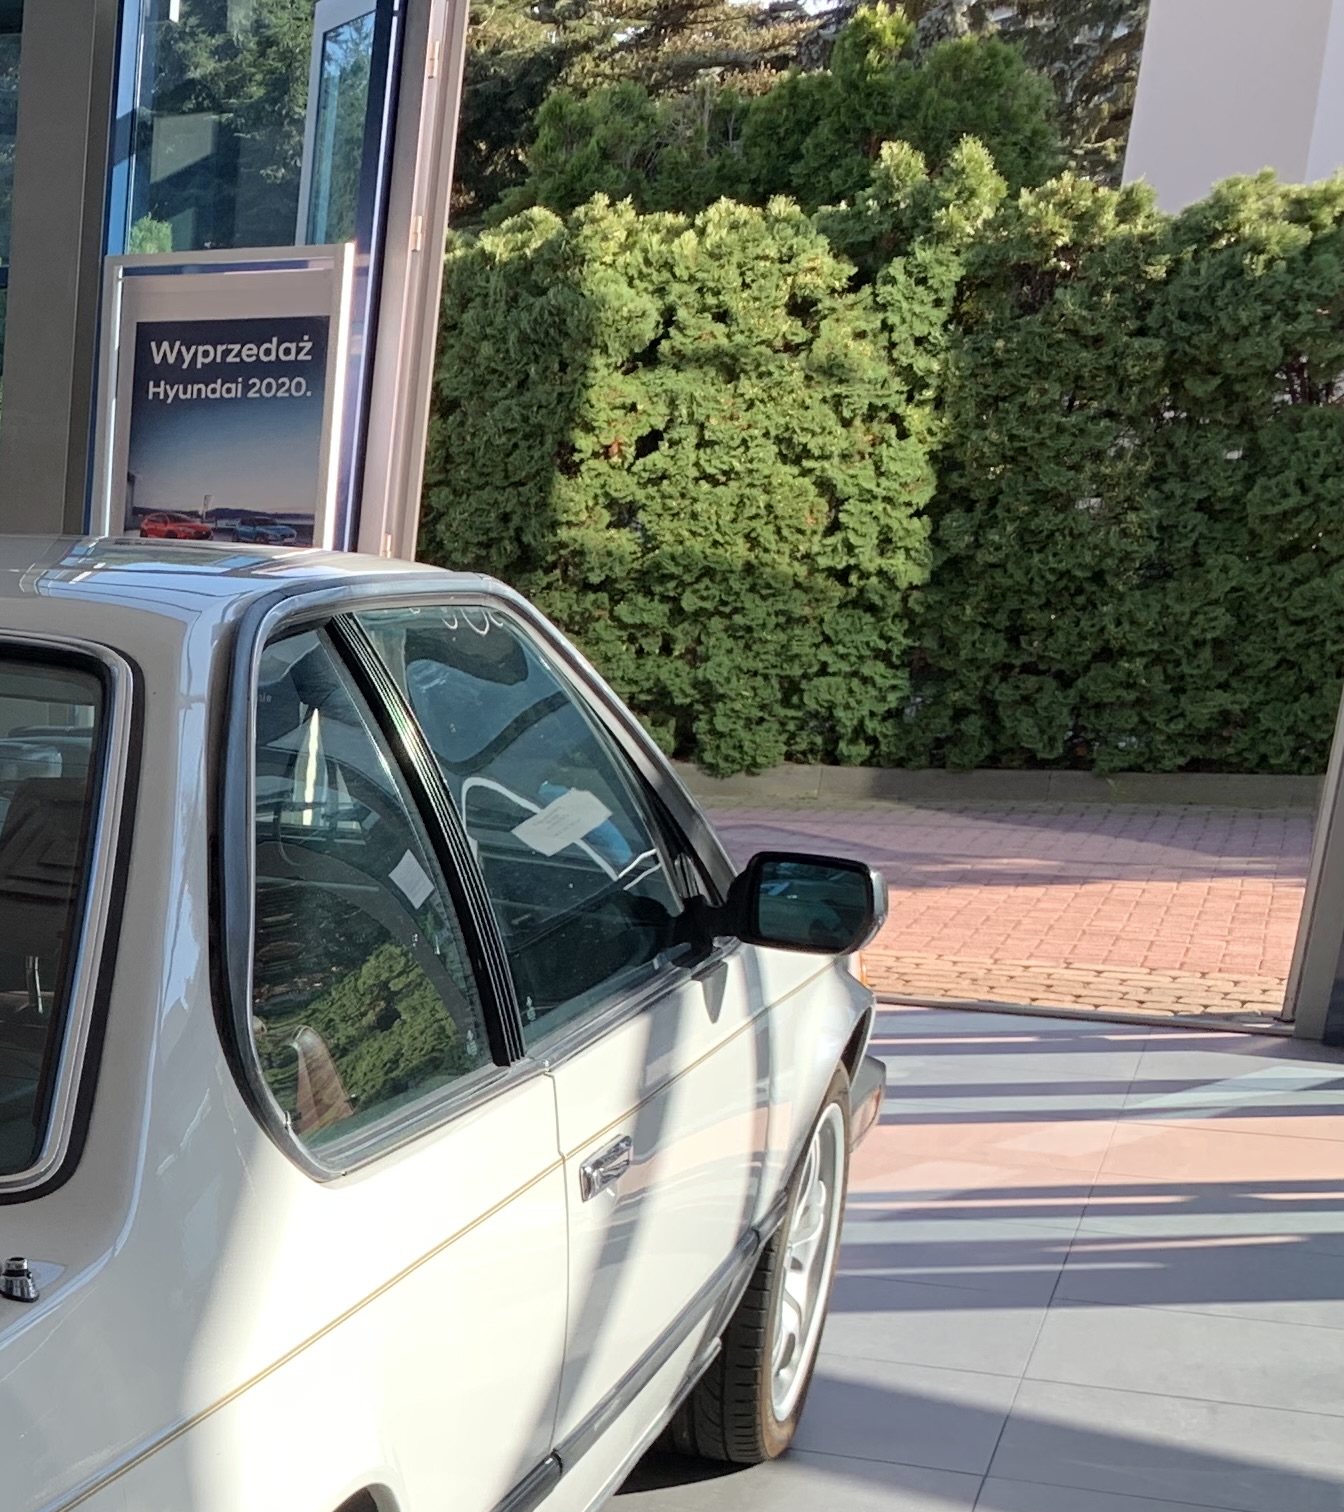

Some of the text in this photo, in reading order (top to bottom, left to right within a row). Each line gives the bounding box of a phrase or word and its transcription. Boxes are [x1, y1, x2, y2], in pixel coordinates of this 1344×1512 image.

[150, 335, 313, 369] Wyprzedaż
[148, 377, 312, 404] Hyundai 2020.
